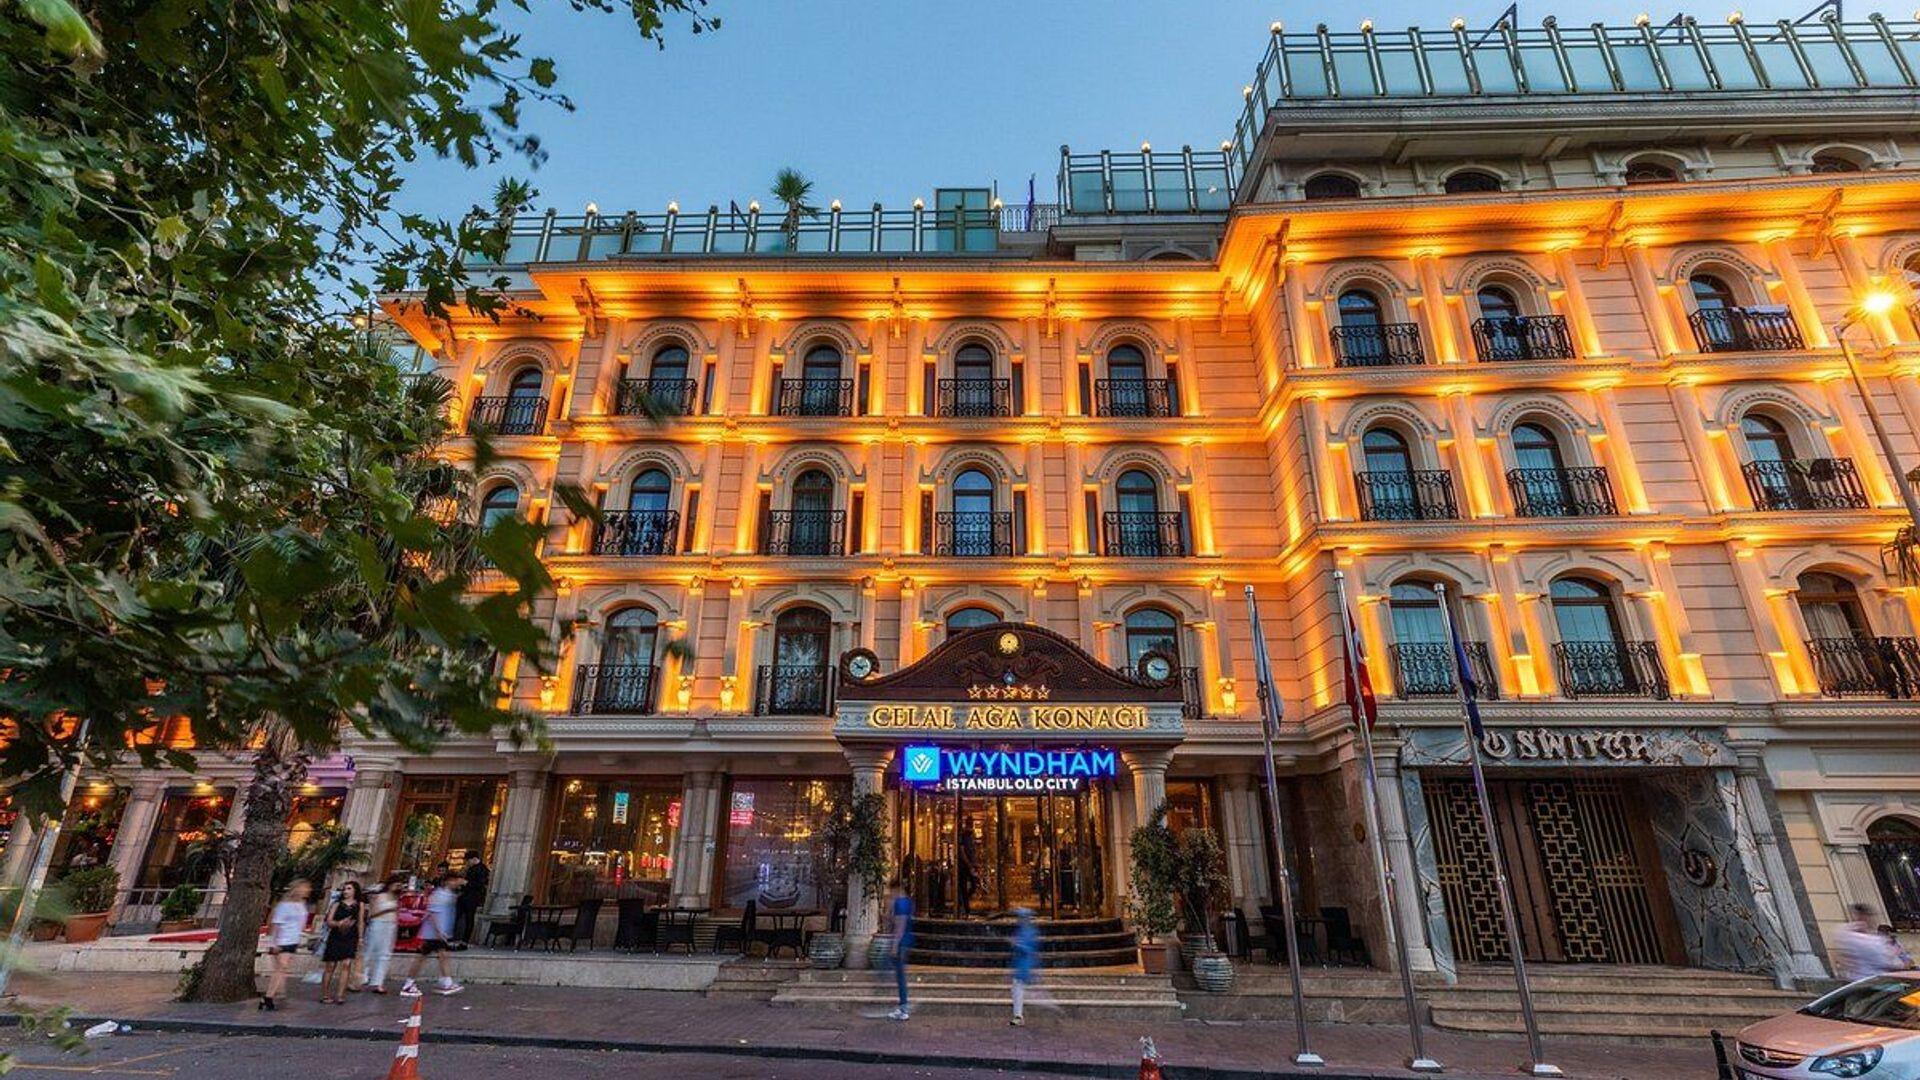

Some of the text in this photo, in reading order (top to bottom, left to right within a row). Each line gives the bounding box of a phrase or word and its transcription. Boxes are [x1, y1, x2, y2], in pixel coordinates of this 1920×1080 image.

[872, 706, 956, 728] CELAL
[947, 751, 1115, 776] WYNDHAM
[947, 778, 1079, 790] ISTANBUL OLD CITY
